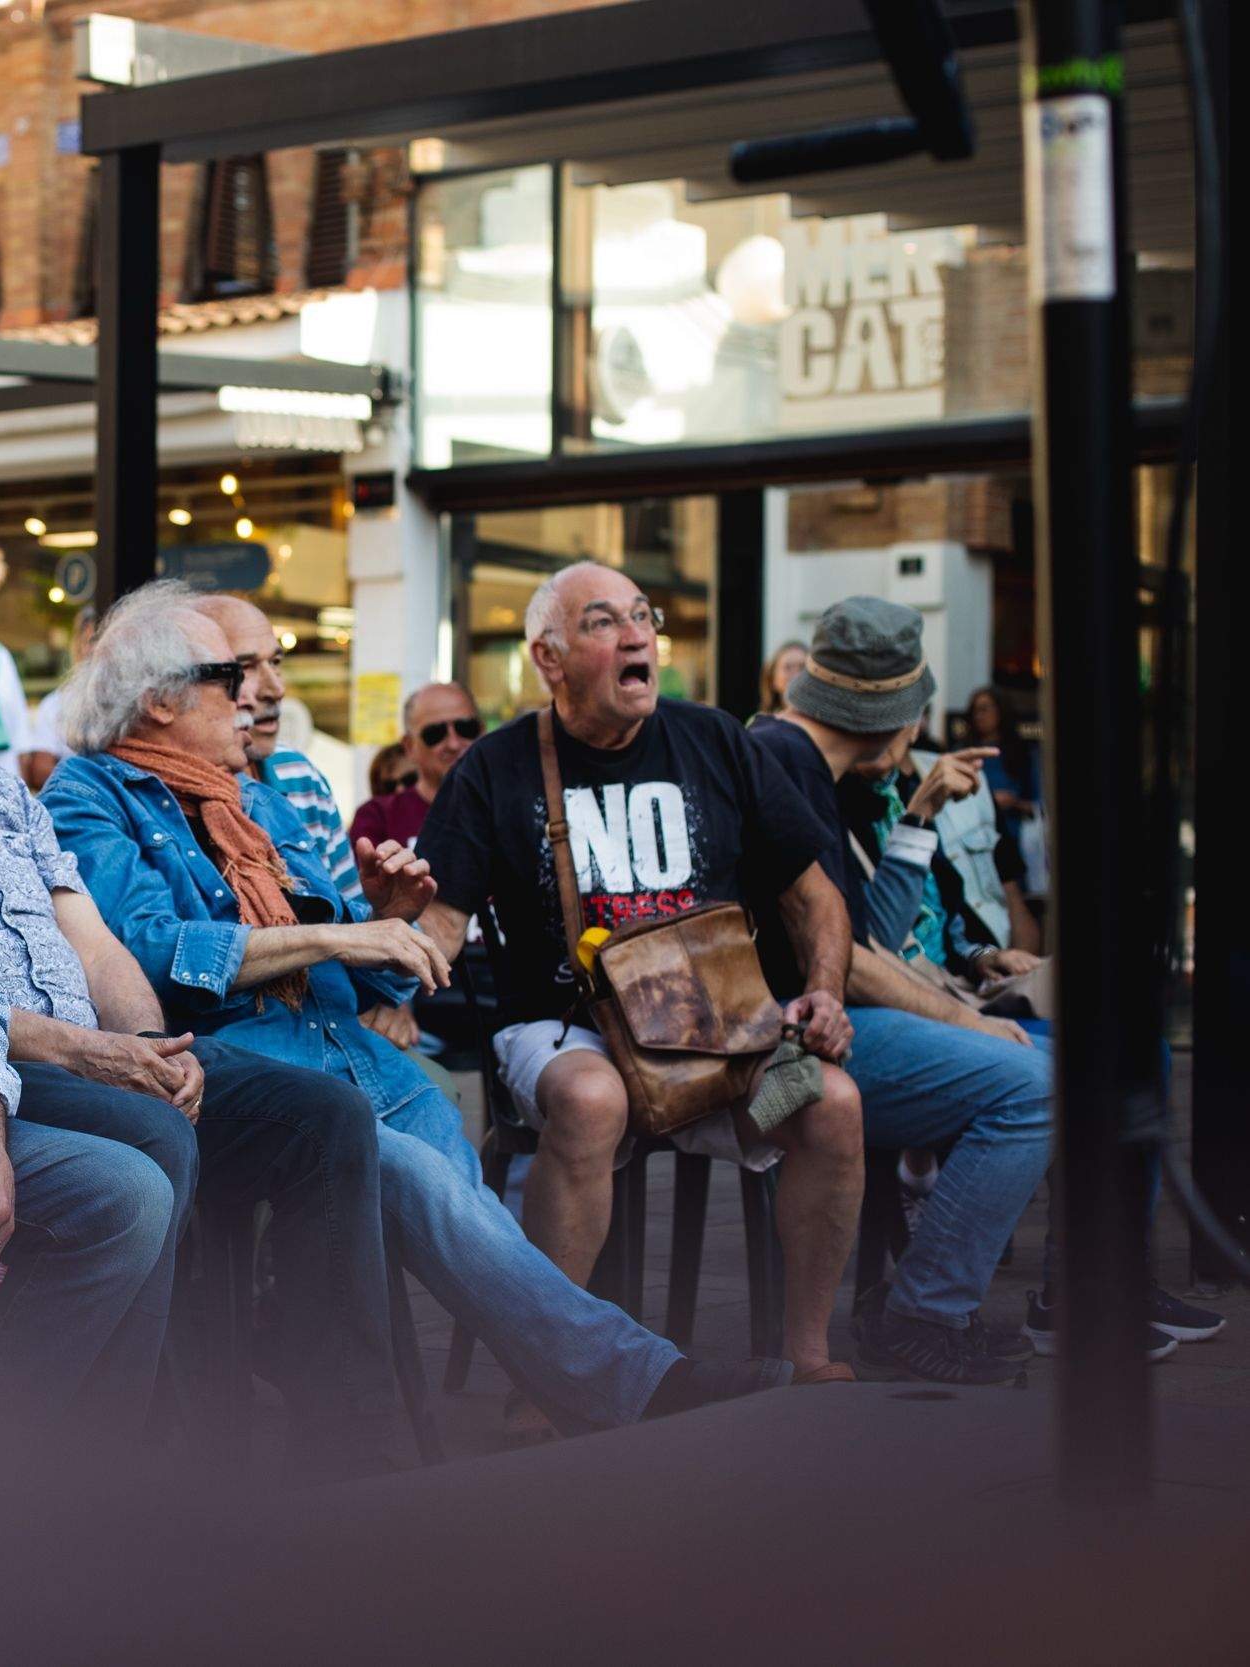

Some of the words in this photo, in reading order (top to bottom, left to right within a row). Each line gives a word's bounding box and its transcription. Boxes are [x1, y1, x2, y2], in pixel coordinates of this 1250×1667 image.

[782, 301, 944, 397] CAT
[564, 781, 692, 893] NO
[582, 888, 695, 927] TRESS
